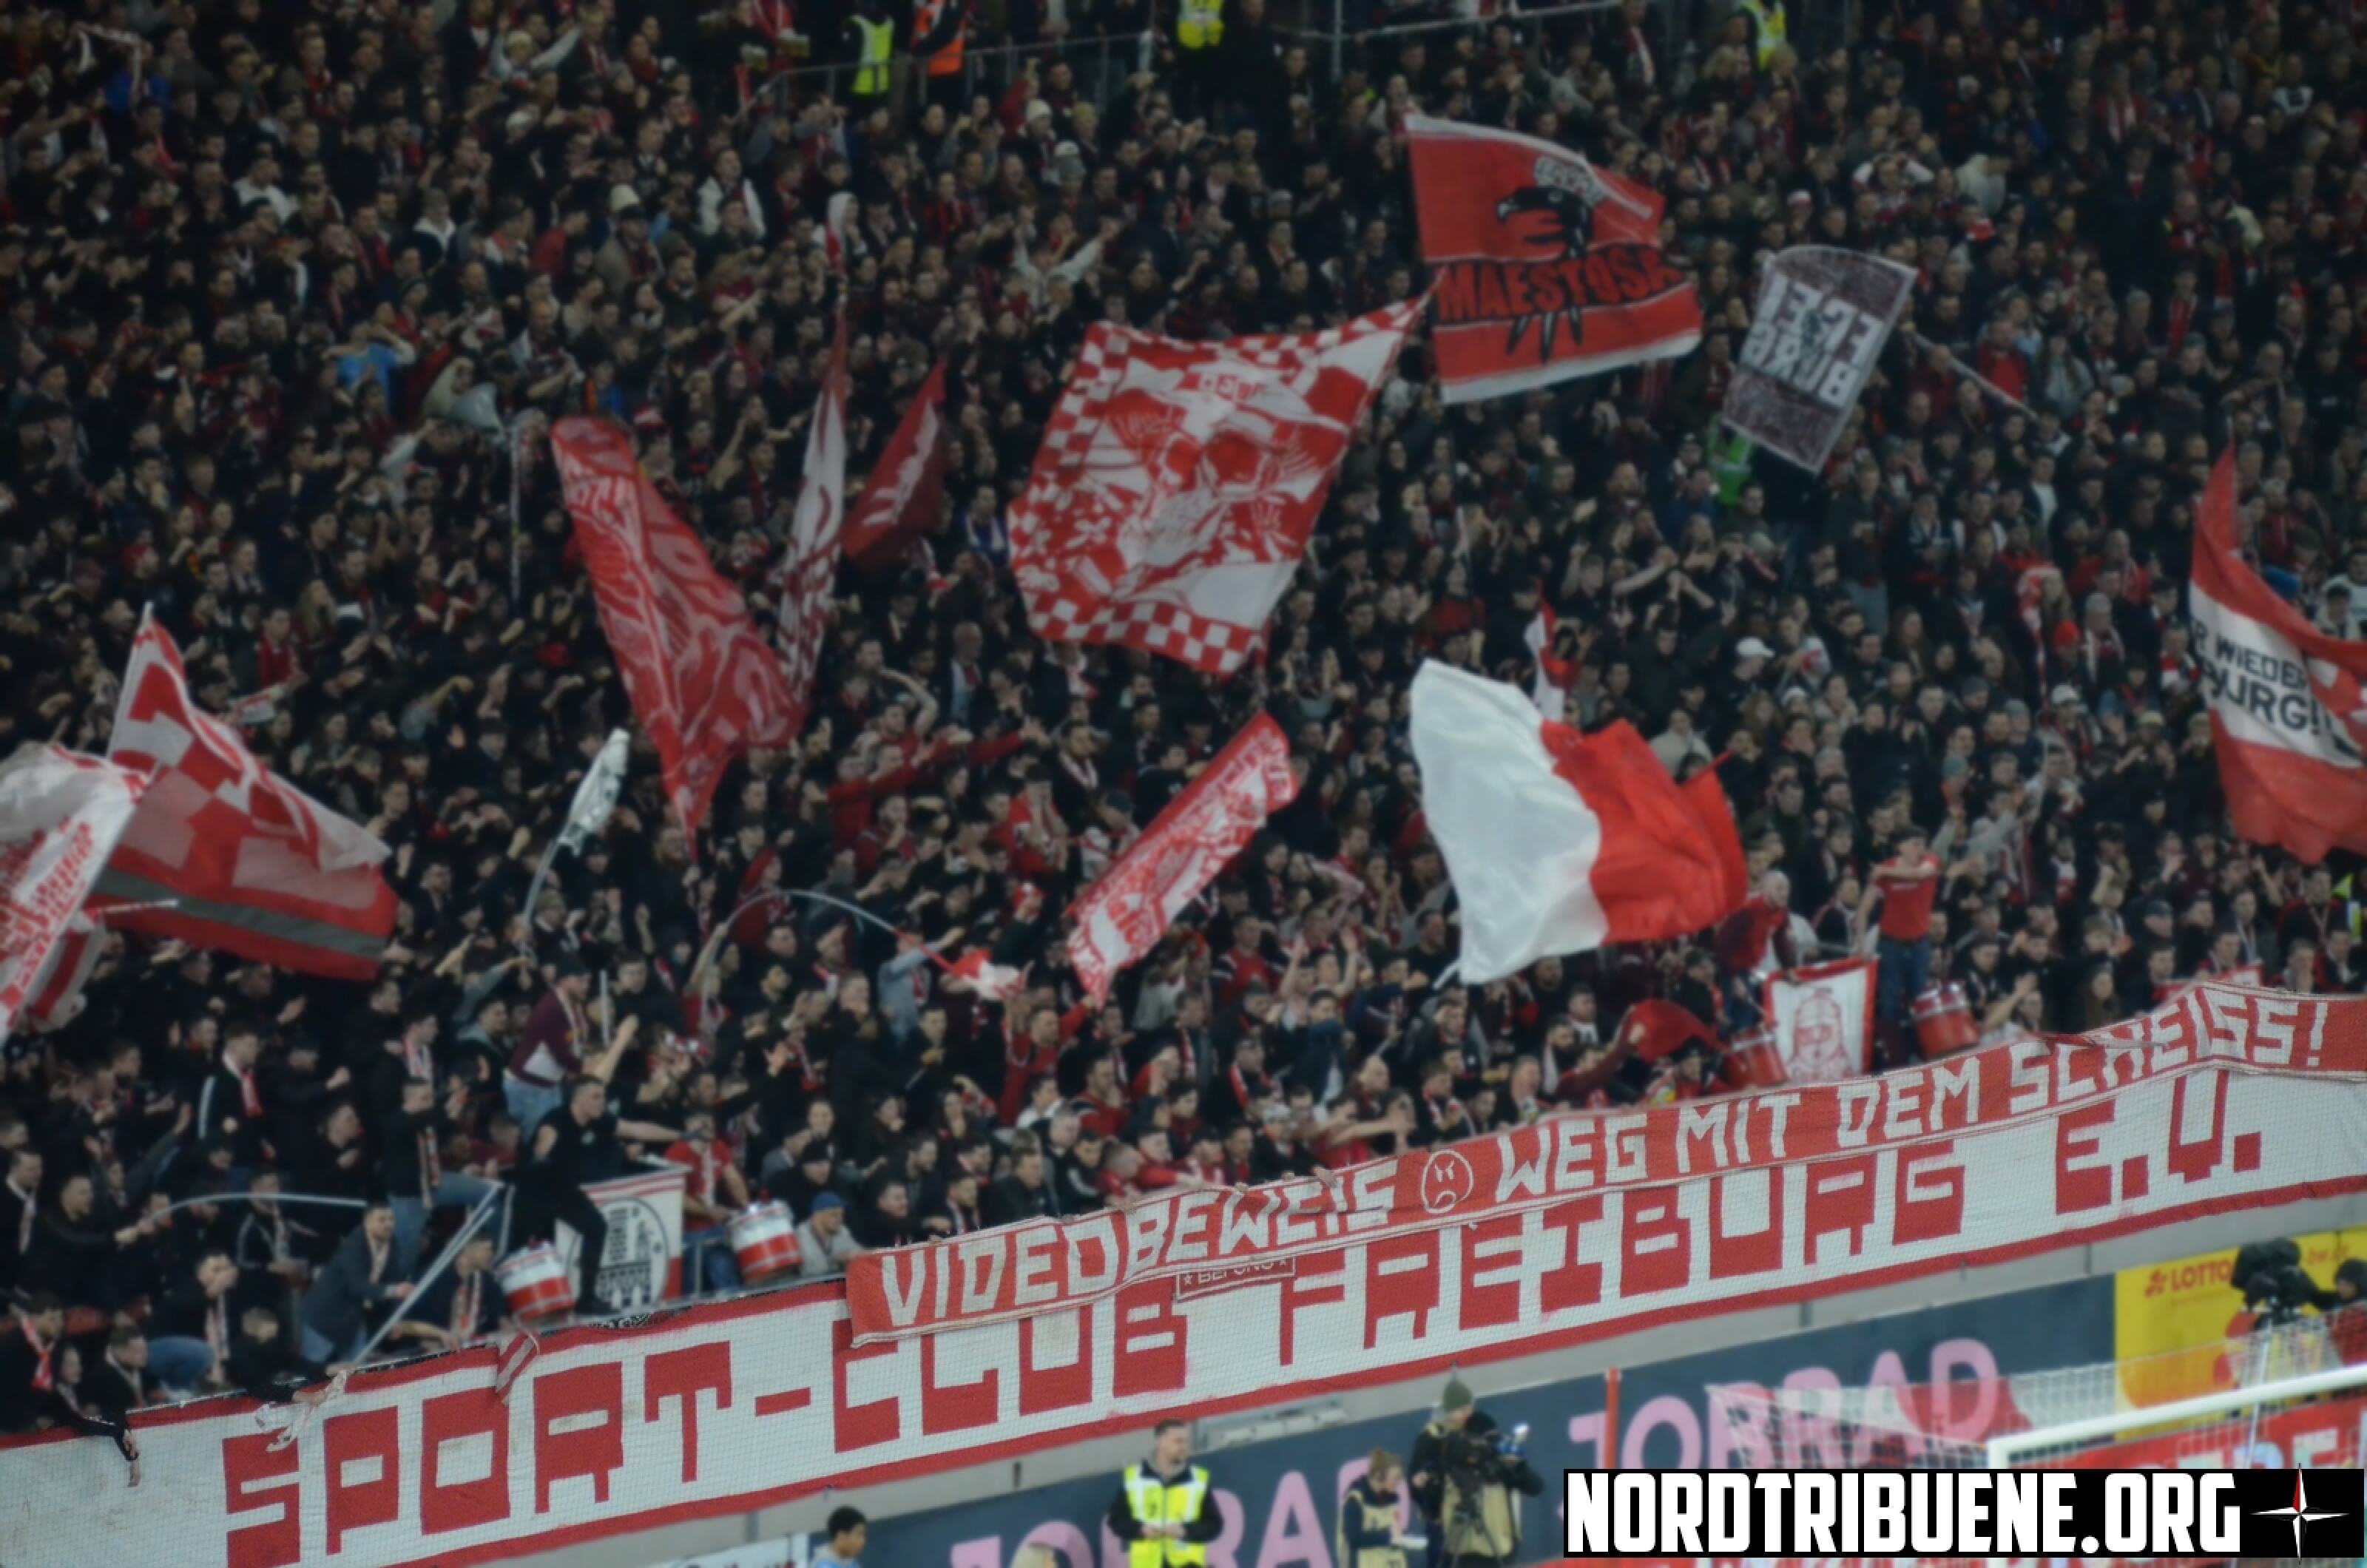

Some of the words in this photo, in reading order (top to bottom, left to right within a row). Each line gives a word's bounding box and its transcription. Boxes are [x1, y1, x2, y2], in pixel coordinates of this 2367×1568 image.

[1436, 247, 1684, 320] MAESTOSA
[882, 1159, 1397, 1328] VIDEOBEWEIS
[1497, 1113, 1647, 1203] WEG
[1676, 1092, 1800, 1173] MIT
[1837, 1058, 1980, 1149] DEM
[2009, 986, 2329, 1115] SCHEISS!
[1280, 1138, 1965, 1365] FREIBURG
[2171, 1259, 2234, 1292] LOTTO
